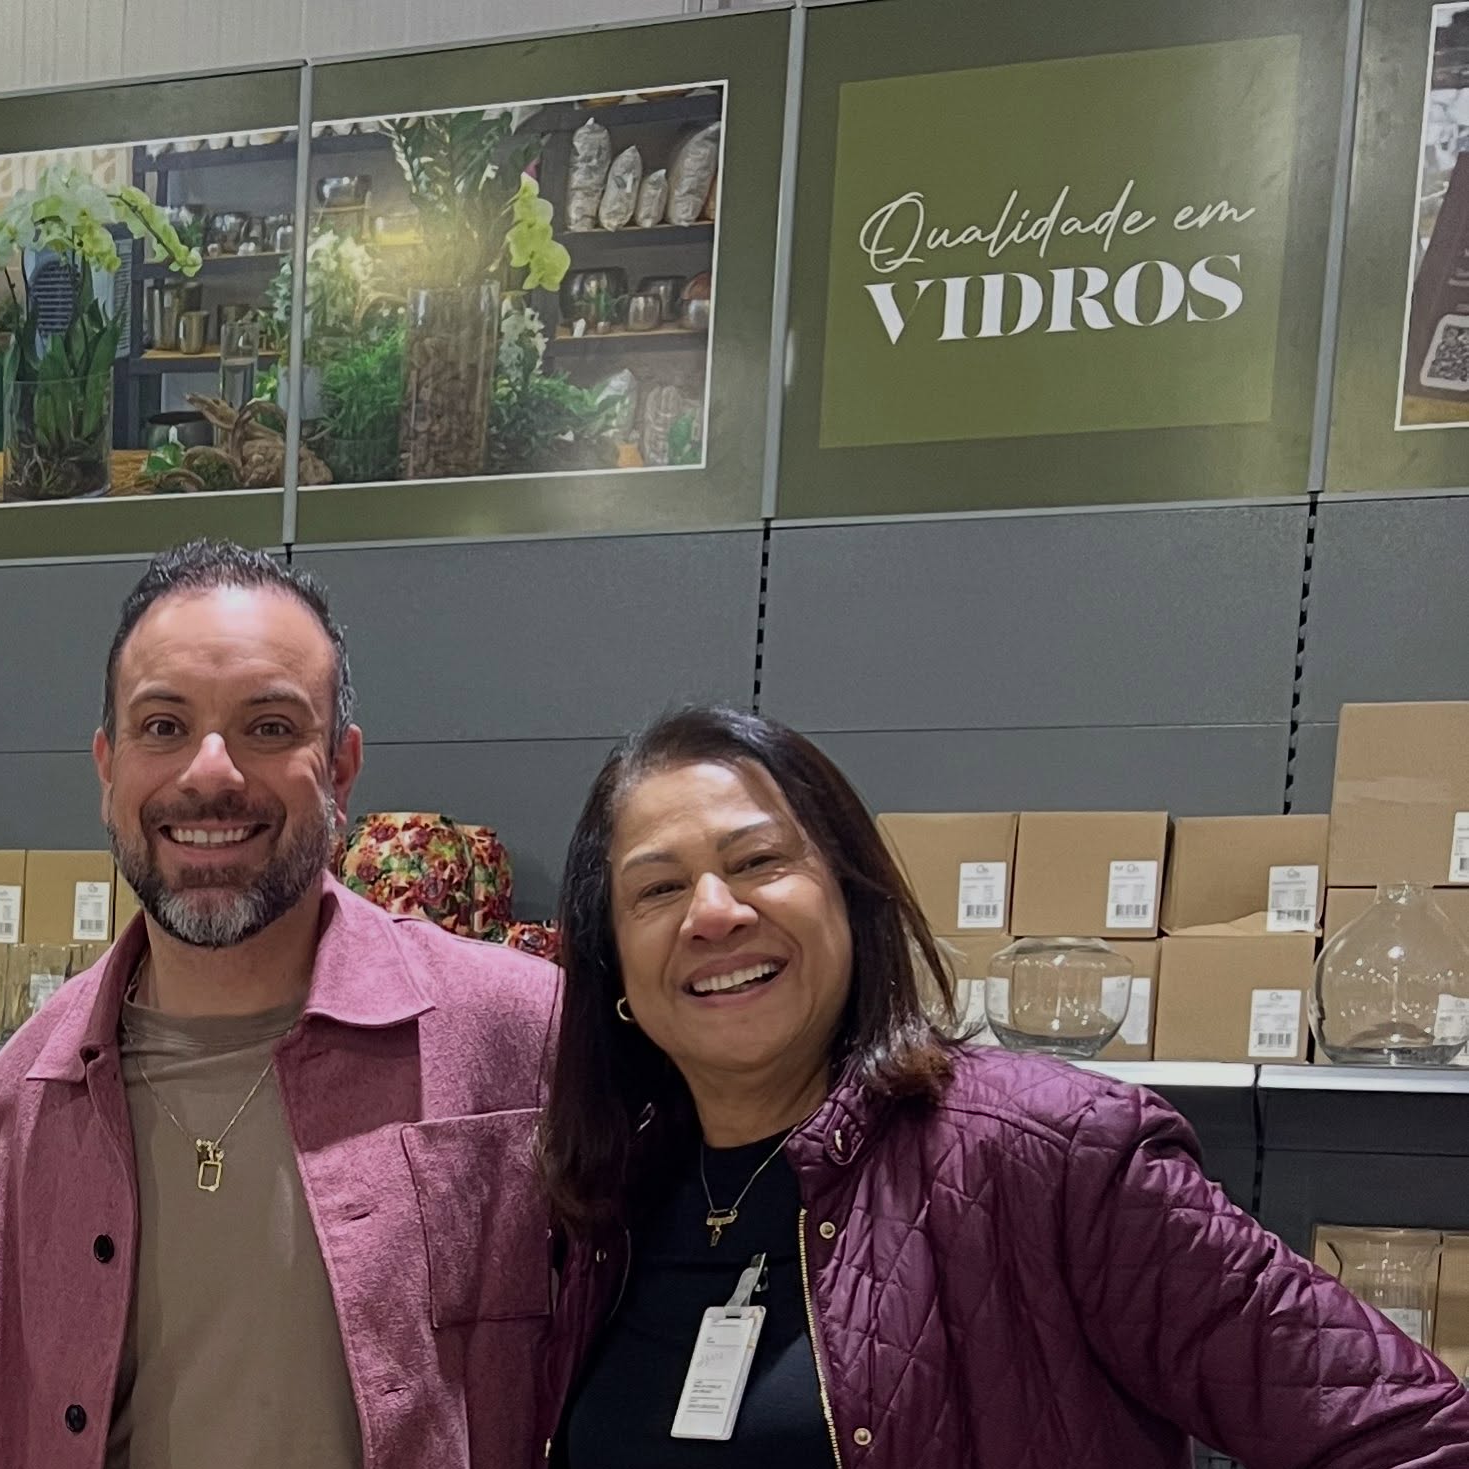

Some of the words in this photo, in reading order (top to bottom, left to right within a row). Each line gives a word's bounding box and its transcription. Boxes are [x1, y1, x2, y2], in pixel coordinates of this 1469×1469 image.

[858, 178, 1156, 274] Qualidade
[1173, 199, 1256, 231] em
[863, 253, 1244, 345] VIDROS
